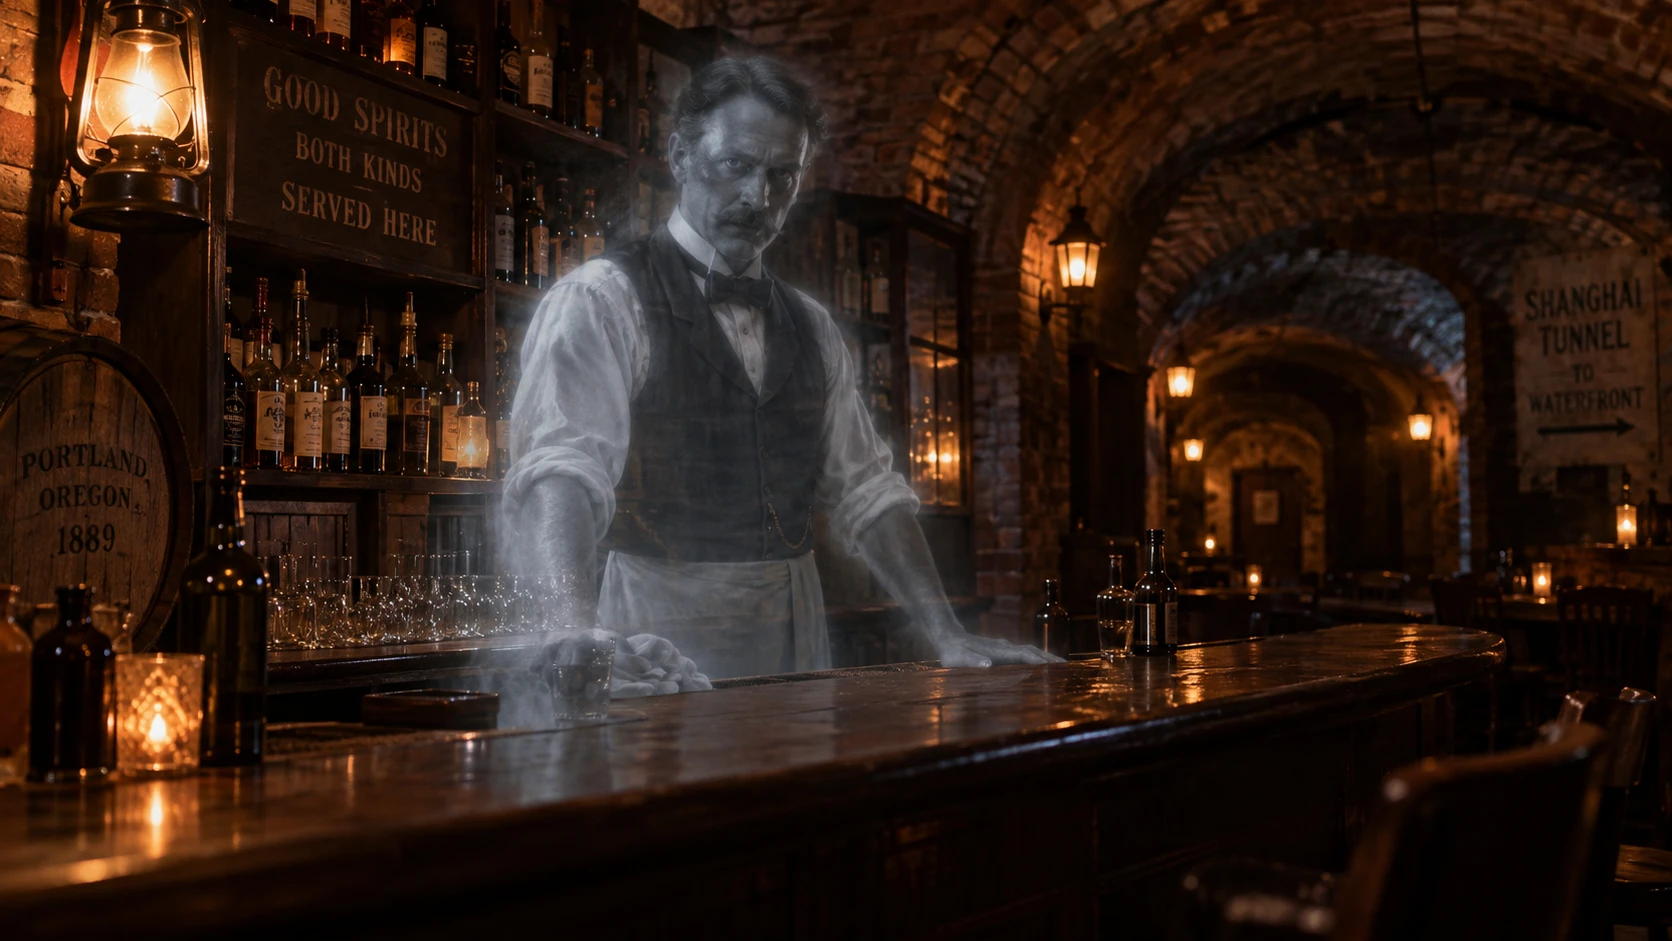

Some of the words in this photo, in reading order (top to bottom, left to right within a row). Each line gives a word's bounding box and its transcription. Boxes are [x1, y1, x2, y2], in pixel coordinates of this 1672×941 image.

[263, 66, 340, 121] GOOD
[354, 96, 447, 157] SPIRITS
[295, 131, 352, 173] BOTH
[363, 152, 422, 193] KINDS
[281, 180, 372, 230] SERVED
[383, 207, 437, 246] HERE
[1525, 279, 1642, 321] SHANGHAI
[1538, 320, 1630, 356] TUNNEL
[1571, 363, 1595, 383] TO
[1529, 386, 1644, 414] WATERFRONT
[58, 524, 115, 555] 1889
